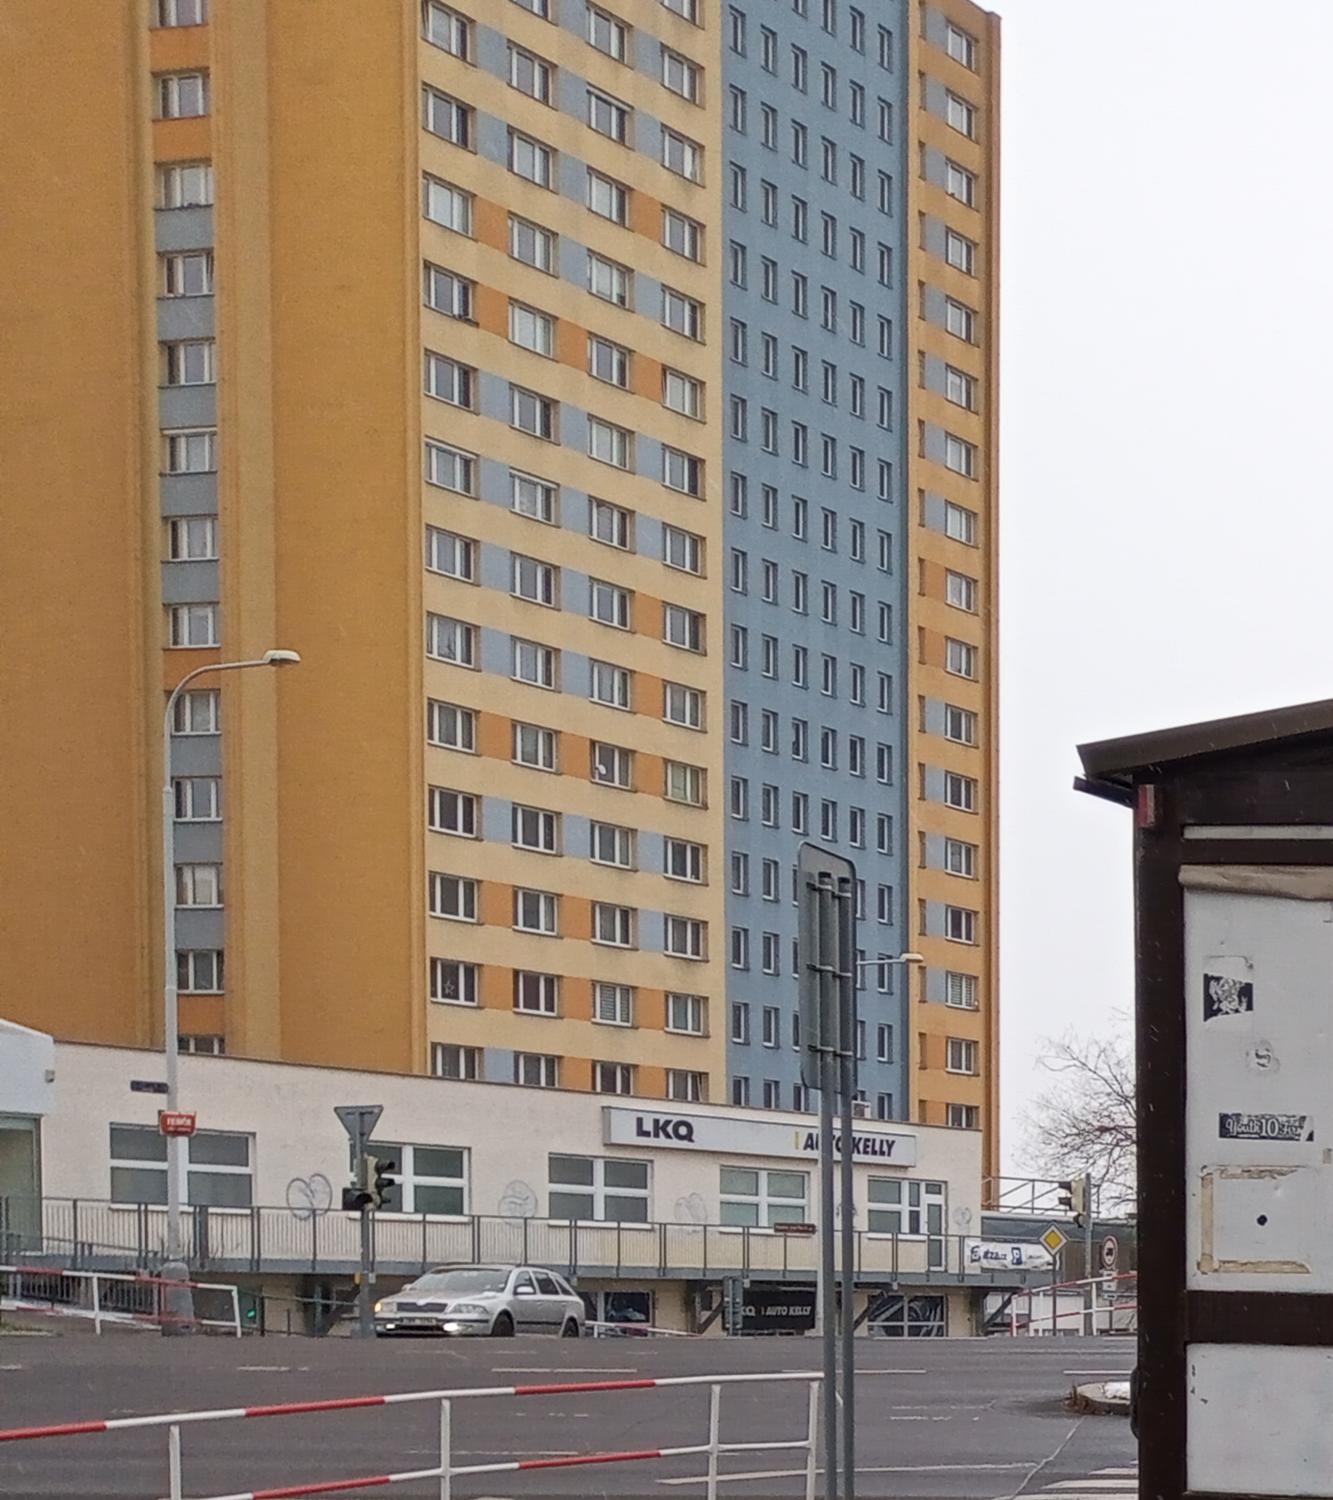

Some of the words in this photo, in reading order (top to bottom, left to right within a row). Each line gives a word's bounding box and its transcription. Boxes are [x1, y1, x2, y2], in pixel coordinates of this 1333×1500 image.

[635, 1116, 695, 1143] LKQ
[803, 1132, 845, 1155] AO
[851, 1136, 896, 1157] KELLY
